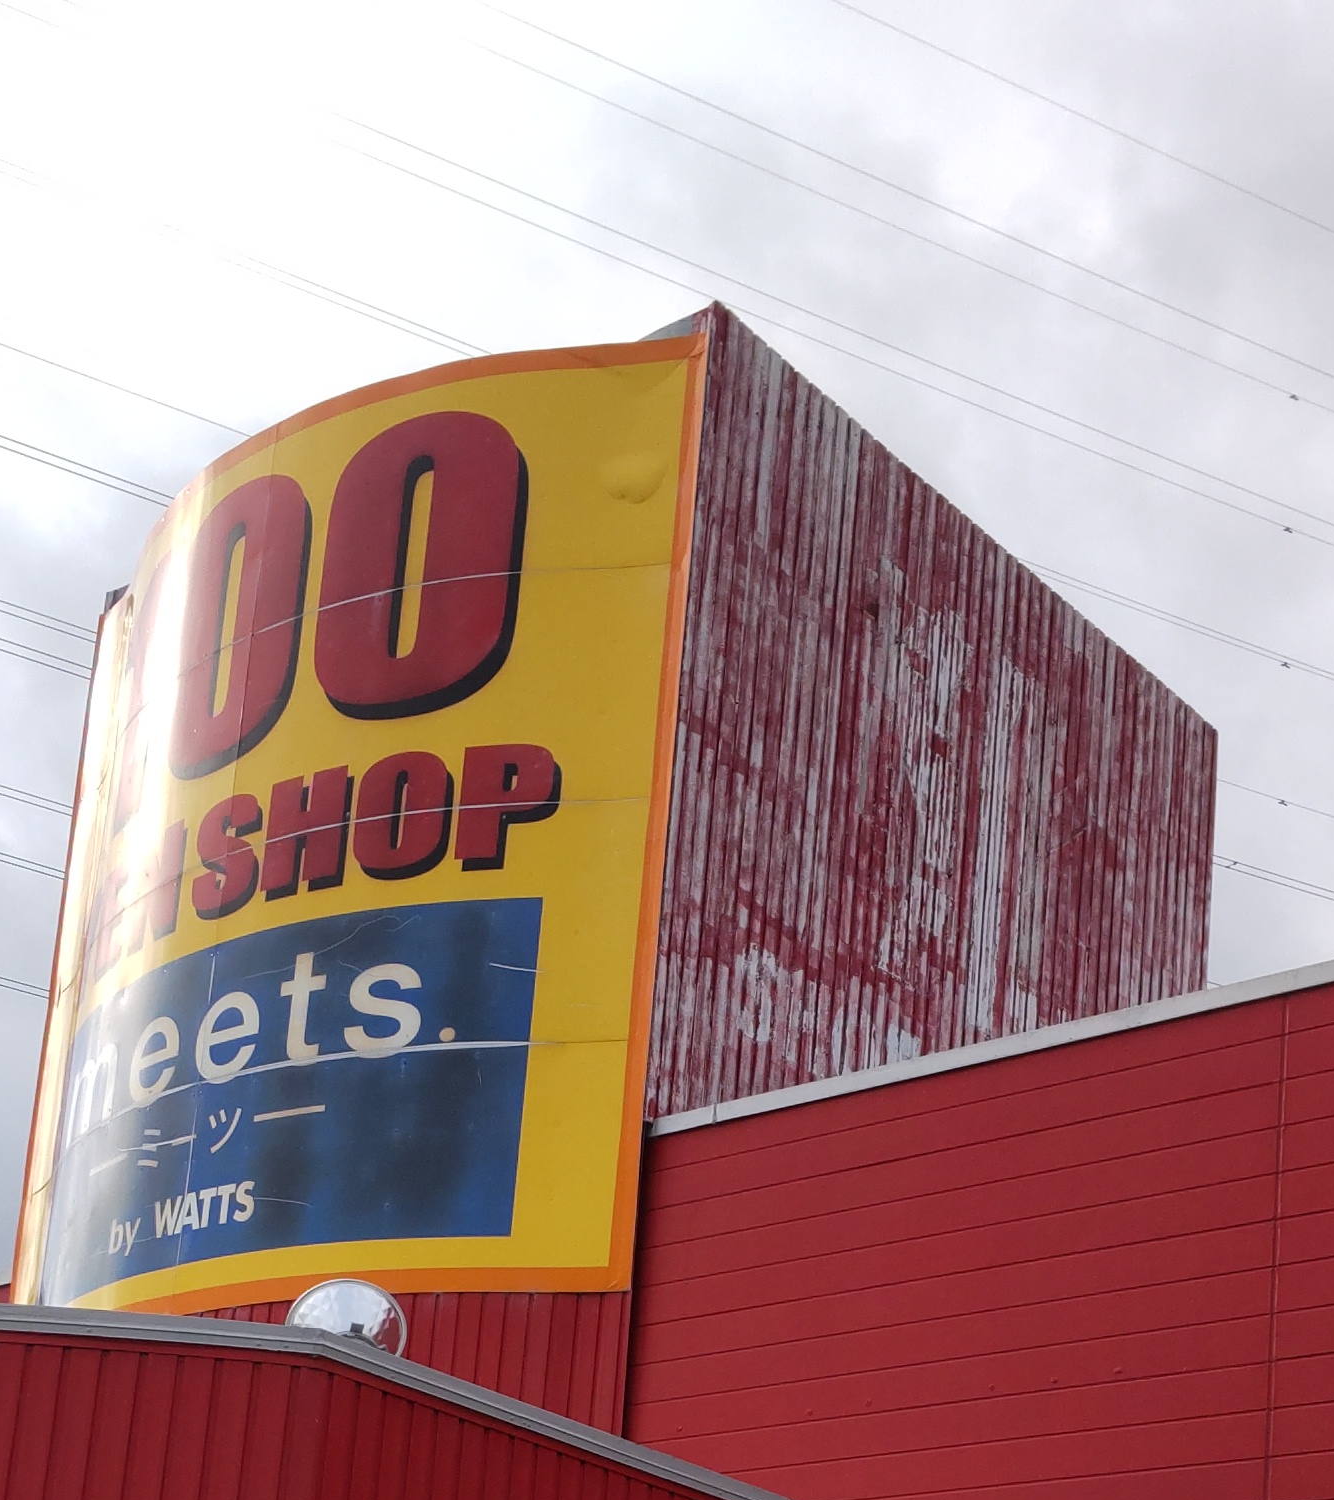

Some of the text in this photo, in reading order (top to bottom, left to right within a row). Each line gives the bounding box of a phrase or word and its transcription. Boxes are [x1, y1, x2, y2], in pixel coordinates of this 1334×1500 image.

[88, 744, 561, 984] EN SHOP
[66, 952, 456, 1148] meets.
[108, 1180, 255, 1257] by WATTS
